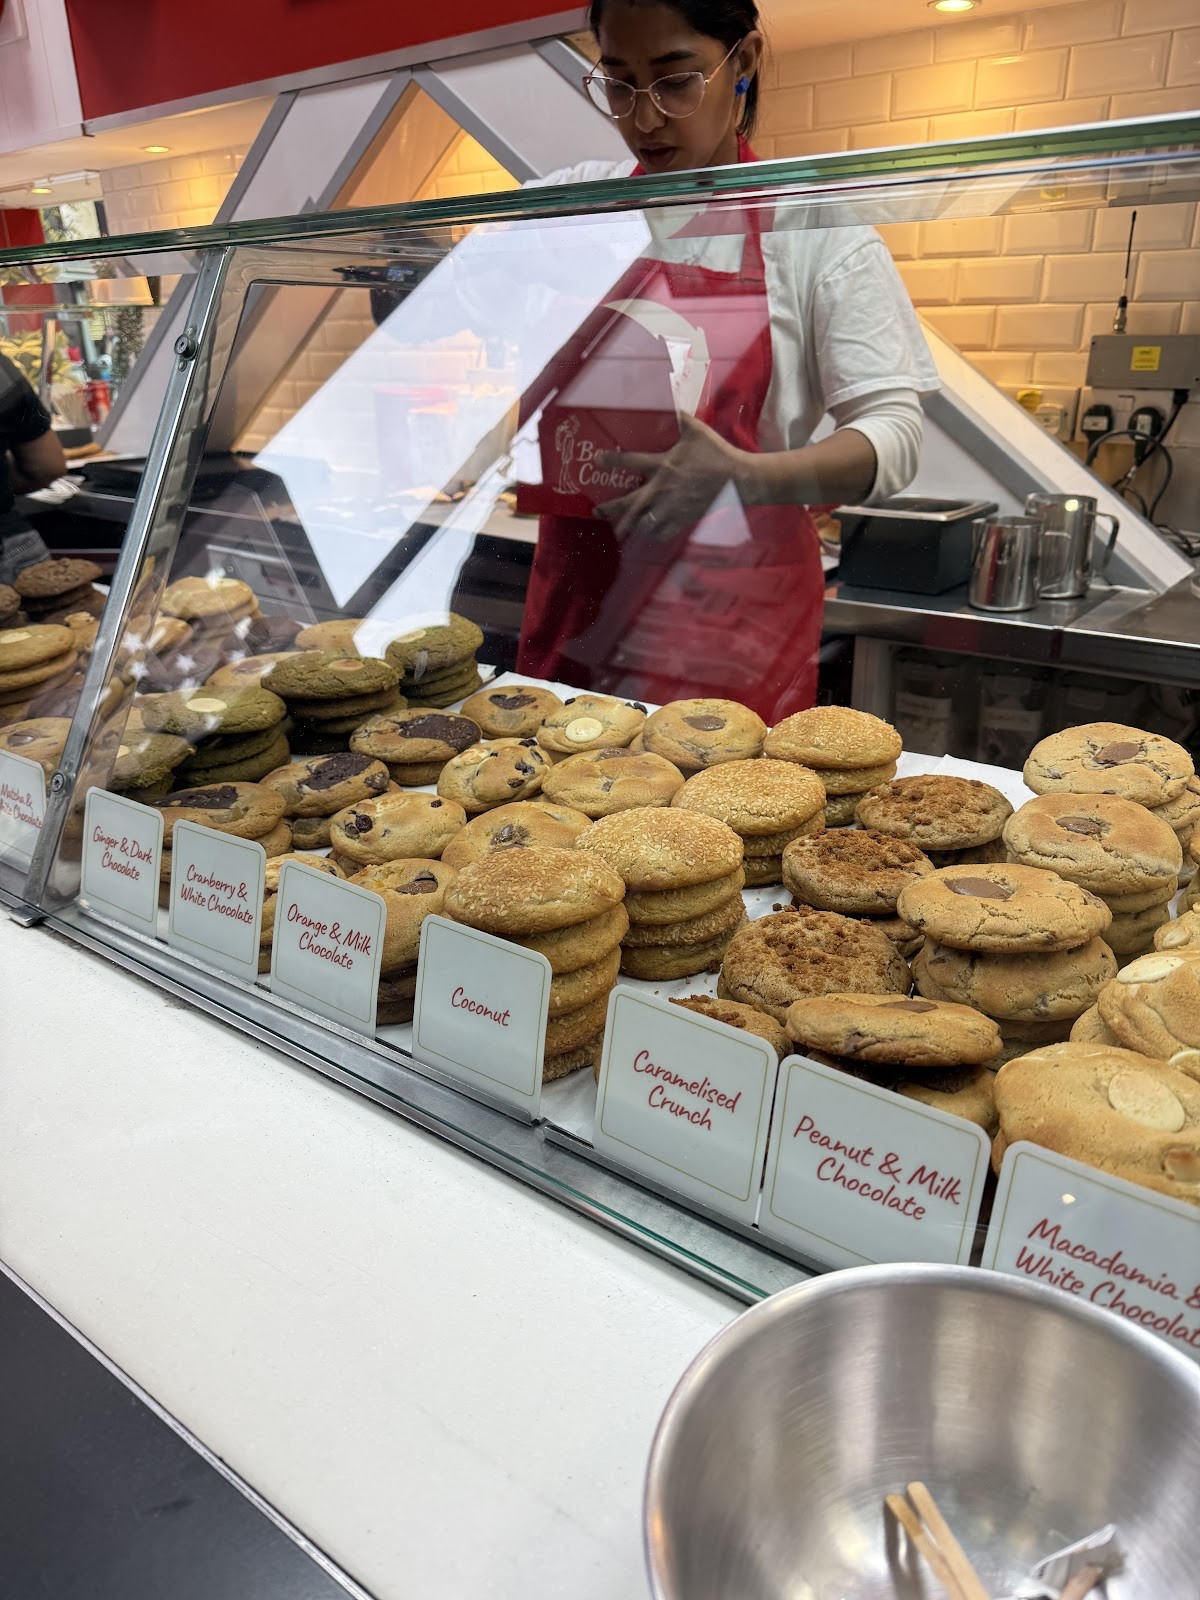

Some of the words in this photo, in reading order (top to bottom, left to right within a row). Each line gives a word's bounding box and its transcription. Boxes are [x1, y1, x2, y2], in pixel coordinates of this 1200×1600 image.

[13, 804, 43, 829] Chocolate
[26, 793, 33, 810] &
[93, 826, 119, 850] Ginger
[119, 837, 129, 857] &
[131, 840, 152, 864] Dark
[102, 852, 140, 880] Chocolate
[187, 864, 235, 899] Cranberry
[237, 882, 247, 902] &
[181, 884, 205, 907] White
[207, 894, 253, 924] Chocolate
[287, 903, 327, 937] Orange
[328, 922, 341, 945] &
[342, 929, 371, 955] Milk
[299, 932, 353, 970] Chocolate
[451, 987, 511, 1027] Coconut
[633, 1050, 742, 1113] Caramelised
[648, 1085, 712, 1131] Crunch
[793, 1115, 873, 1167] Peanut
[877, 1152, 901, 1183] &
[907, 1165, 961, 1205] Milk
[816, 1157, 926, 1220] Chocolate
[1027, 1217, 1179, 1300] Macadamia
[1015, 1246, 1085, 1294] White
[1090, 1281, 1200, 1349] Chocolat
